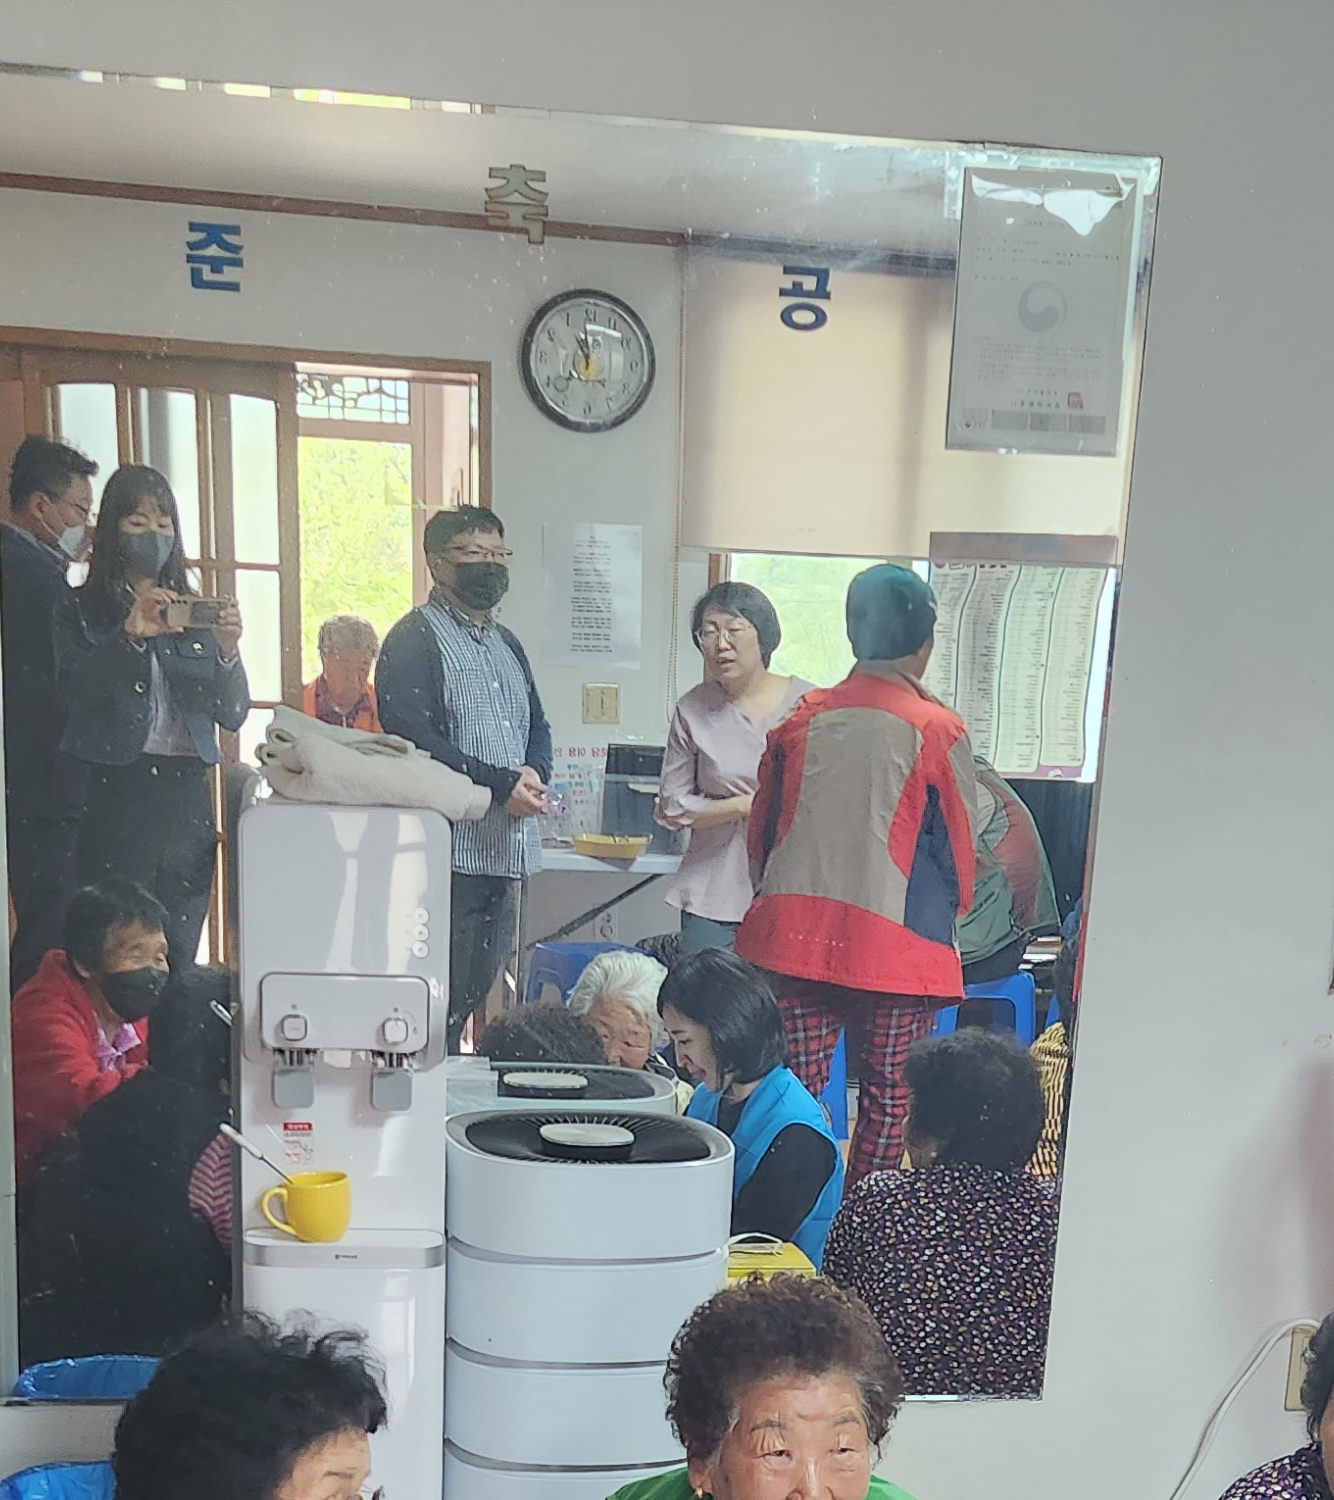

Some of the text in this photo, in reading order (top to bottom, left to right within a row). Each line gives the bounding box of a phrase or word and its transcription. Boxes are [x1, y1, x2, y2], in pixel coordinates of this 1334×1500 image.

[484, 163, 549, 244] 축
[185, 220, 832, 333] 준 공
